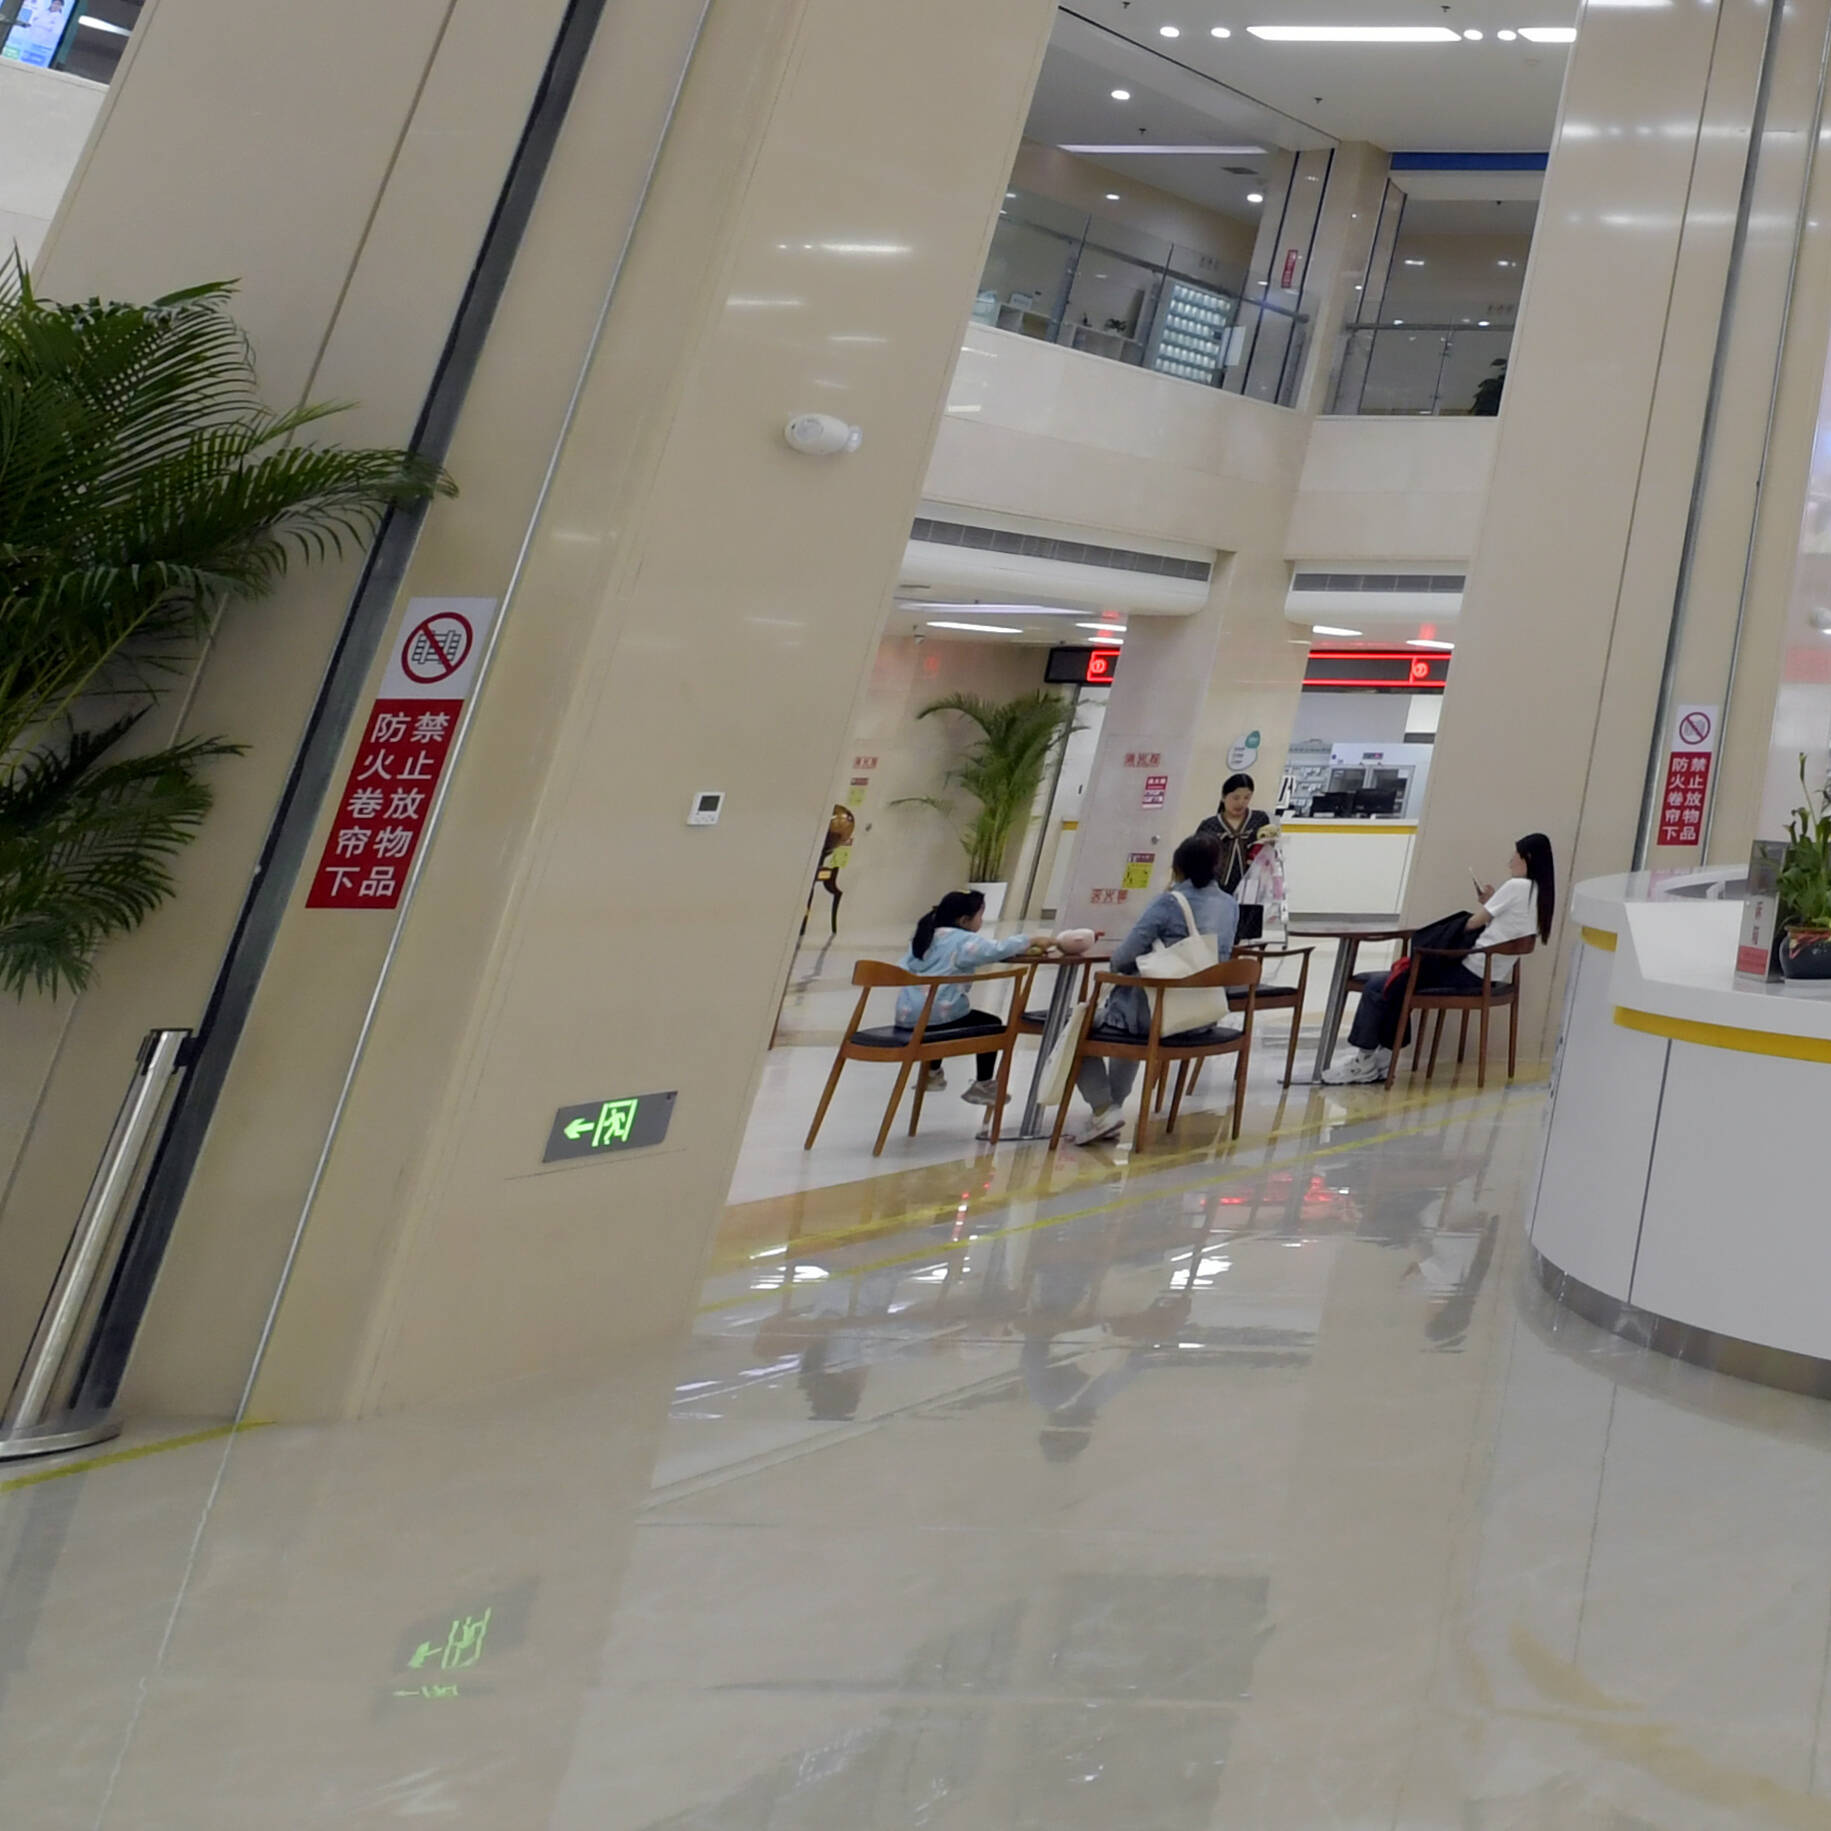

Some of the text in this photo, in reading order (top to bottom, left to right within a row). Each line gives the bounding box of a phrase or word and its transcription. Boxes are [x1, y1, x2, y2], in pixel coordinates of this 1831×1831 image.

[325, 712, 411, 897] 防火卷帘下
[358, 711, 450, 897] 禁止放物品
